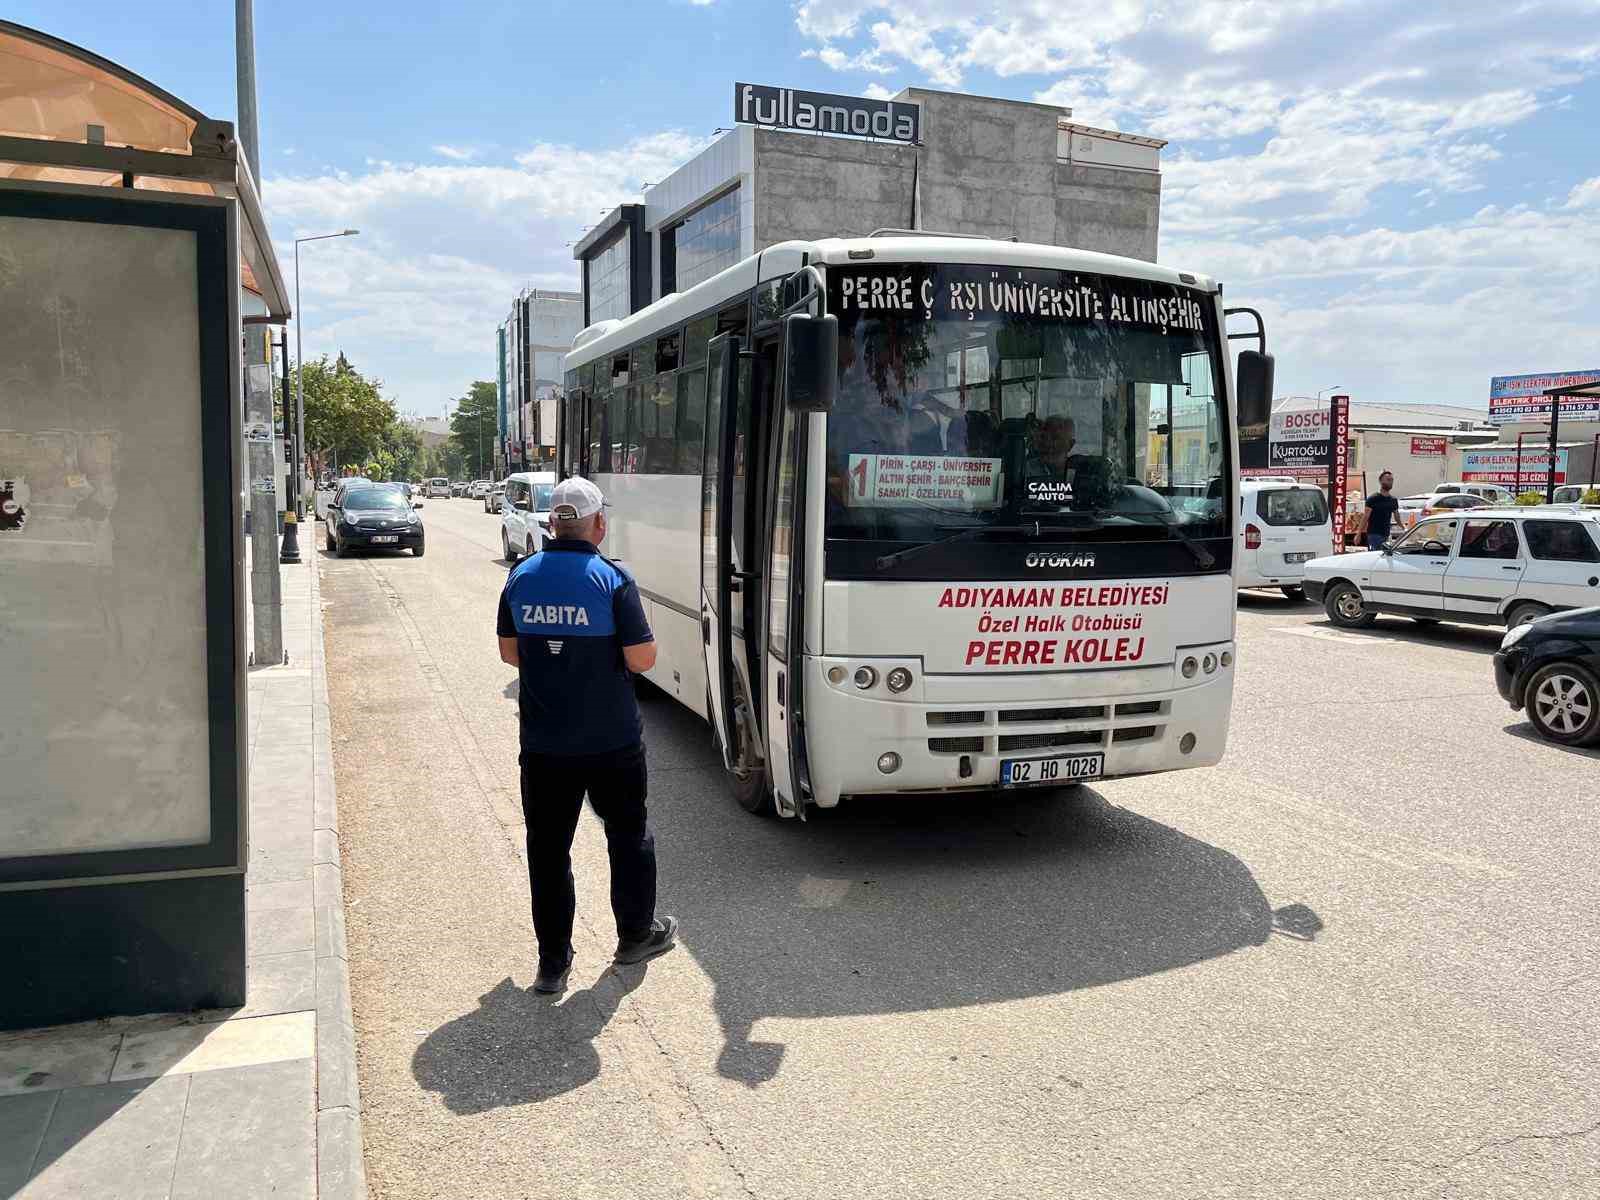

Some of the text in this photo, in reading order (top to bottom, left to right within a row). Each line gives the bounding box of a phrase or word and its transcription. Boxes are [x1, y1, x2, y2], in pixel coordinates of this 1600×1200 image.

[743, 86, 914, 139] fullamoda
[842, 276, 913, 309] PERRE
[990, 272, 1103, 321] ÜNİVERSİTE
[1111, 290, 1203, 334] ALTINŞEHİR
[1285, 412, 1329, 428] BOSCH
[1273, 444, 1328, 459] KURTOĞLU
[880, 457, 993, 473] PİRİN ÇARŞI ÜNİVERSİTE
[850, 458, 868, 497] 1
[879, 474, 992, 487] ALTIN ŞEHİR BAHÇEŞEHİR
[1028, 482, 1073, 493] ÇALIM
[1037, 492, 1064, 501] AUTO
[1025, 552, 1096, 568] OTOKAR
[938, 582, 1169, 608] ADIYAMAN BELEDİYESİ
[521, 604, 589, 626] ZABITA
[977, 611, 1142, 633] Özel Halk Otobüsü
[964, 637, 1145, 665] PERRE KOLEJ
[1012, 763, 1031, 781] 02
[1066, 757, 1098, 777] 1028
